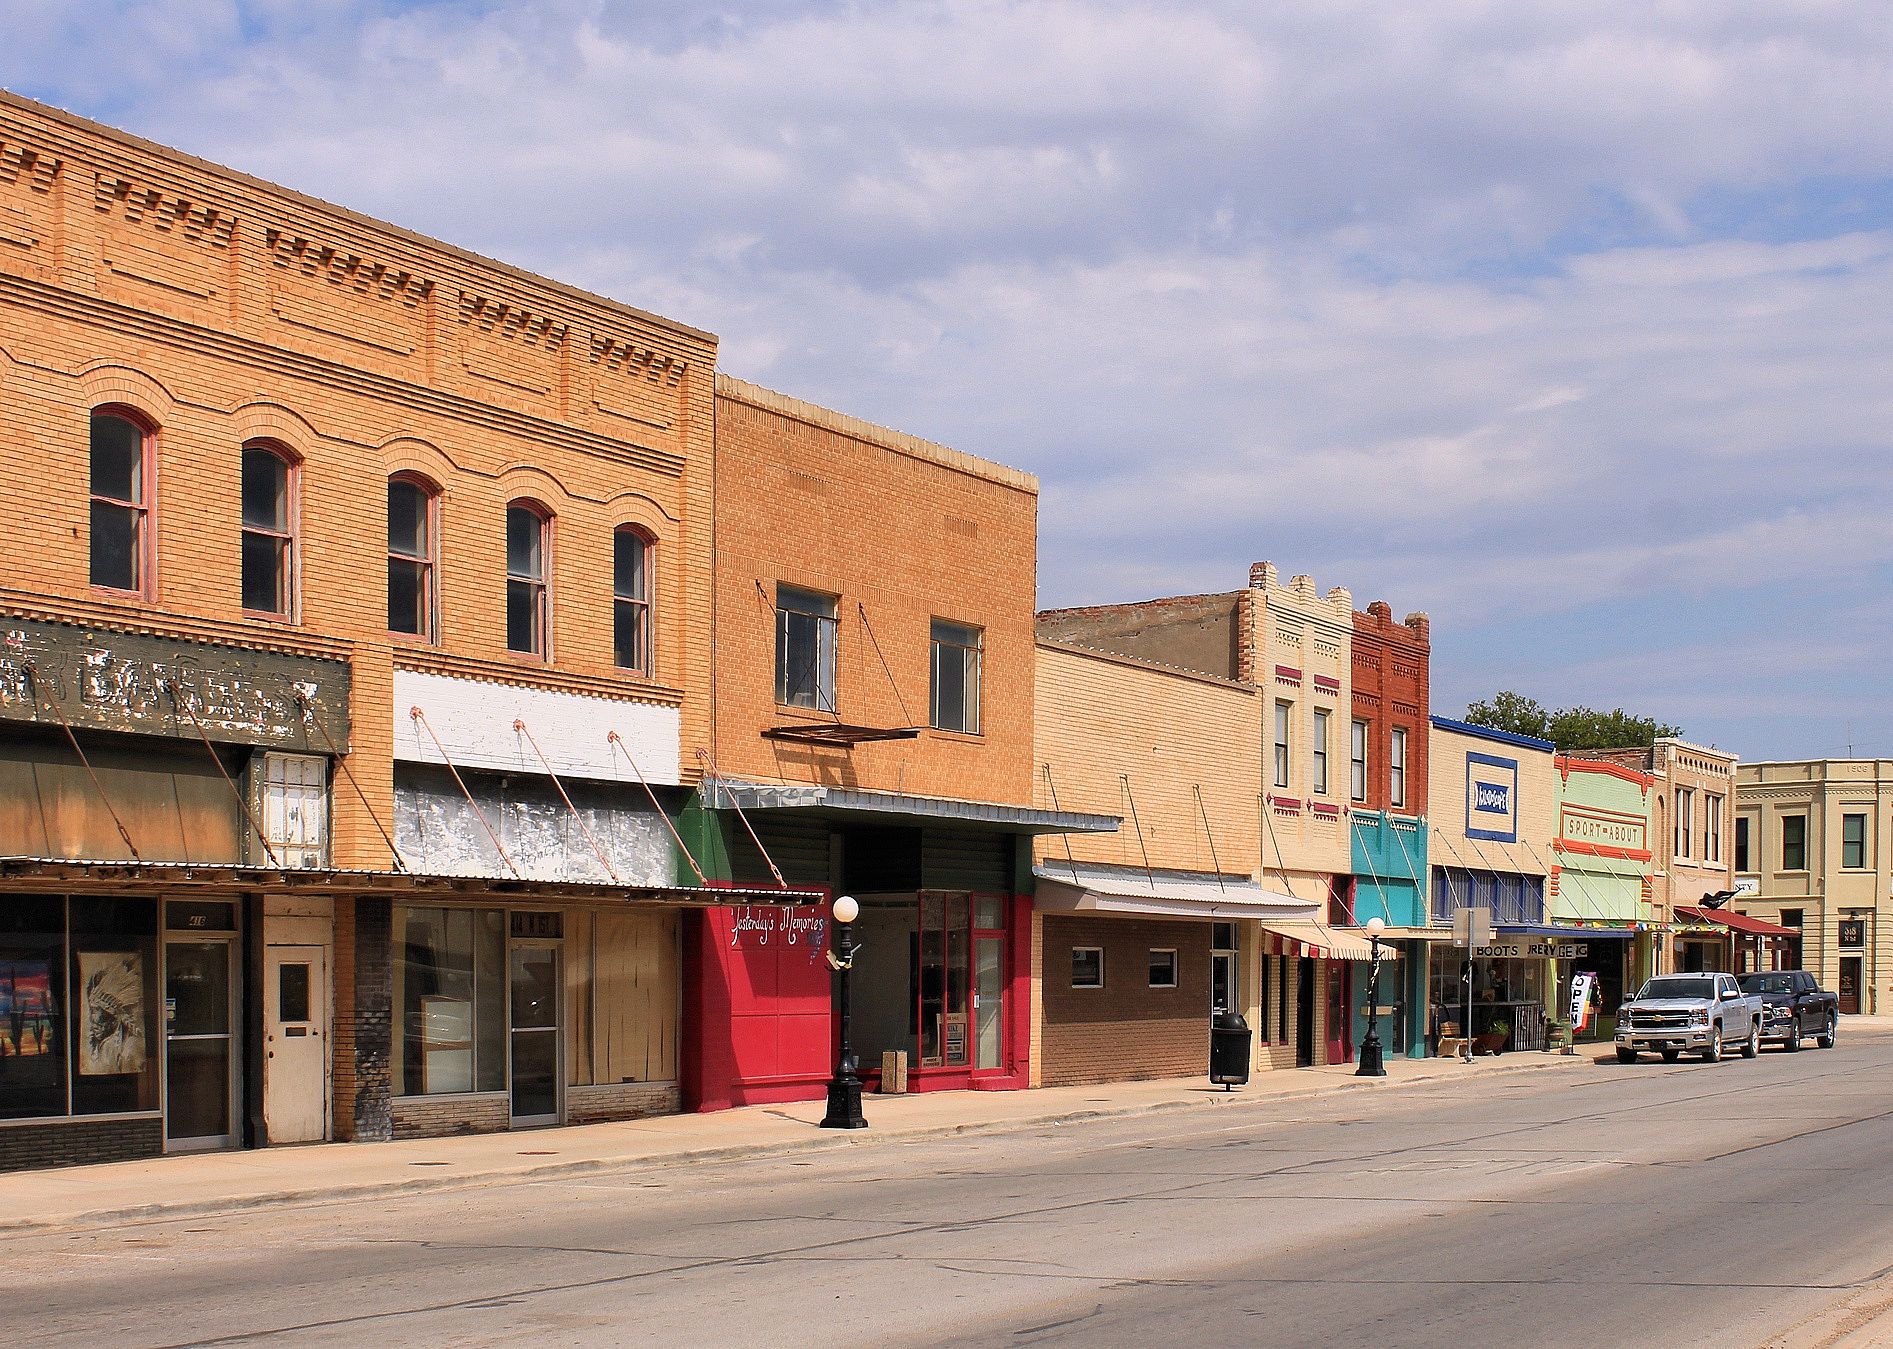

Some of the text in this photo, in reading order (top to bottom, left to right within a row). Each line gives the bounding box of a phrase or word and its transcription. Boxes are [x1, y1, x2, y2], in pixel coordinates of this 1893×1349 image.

[731, 906, 824, 947] Yesterday's Memories
[1476, 945, 1519, 957] BOOTS
[1571, 977, 1585, 1025] OPEN
